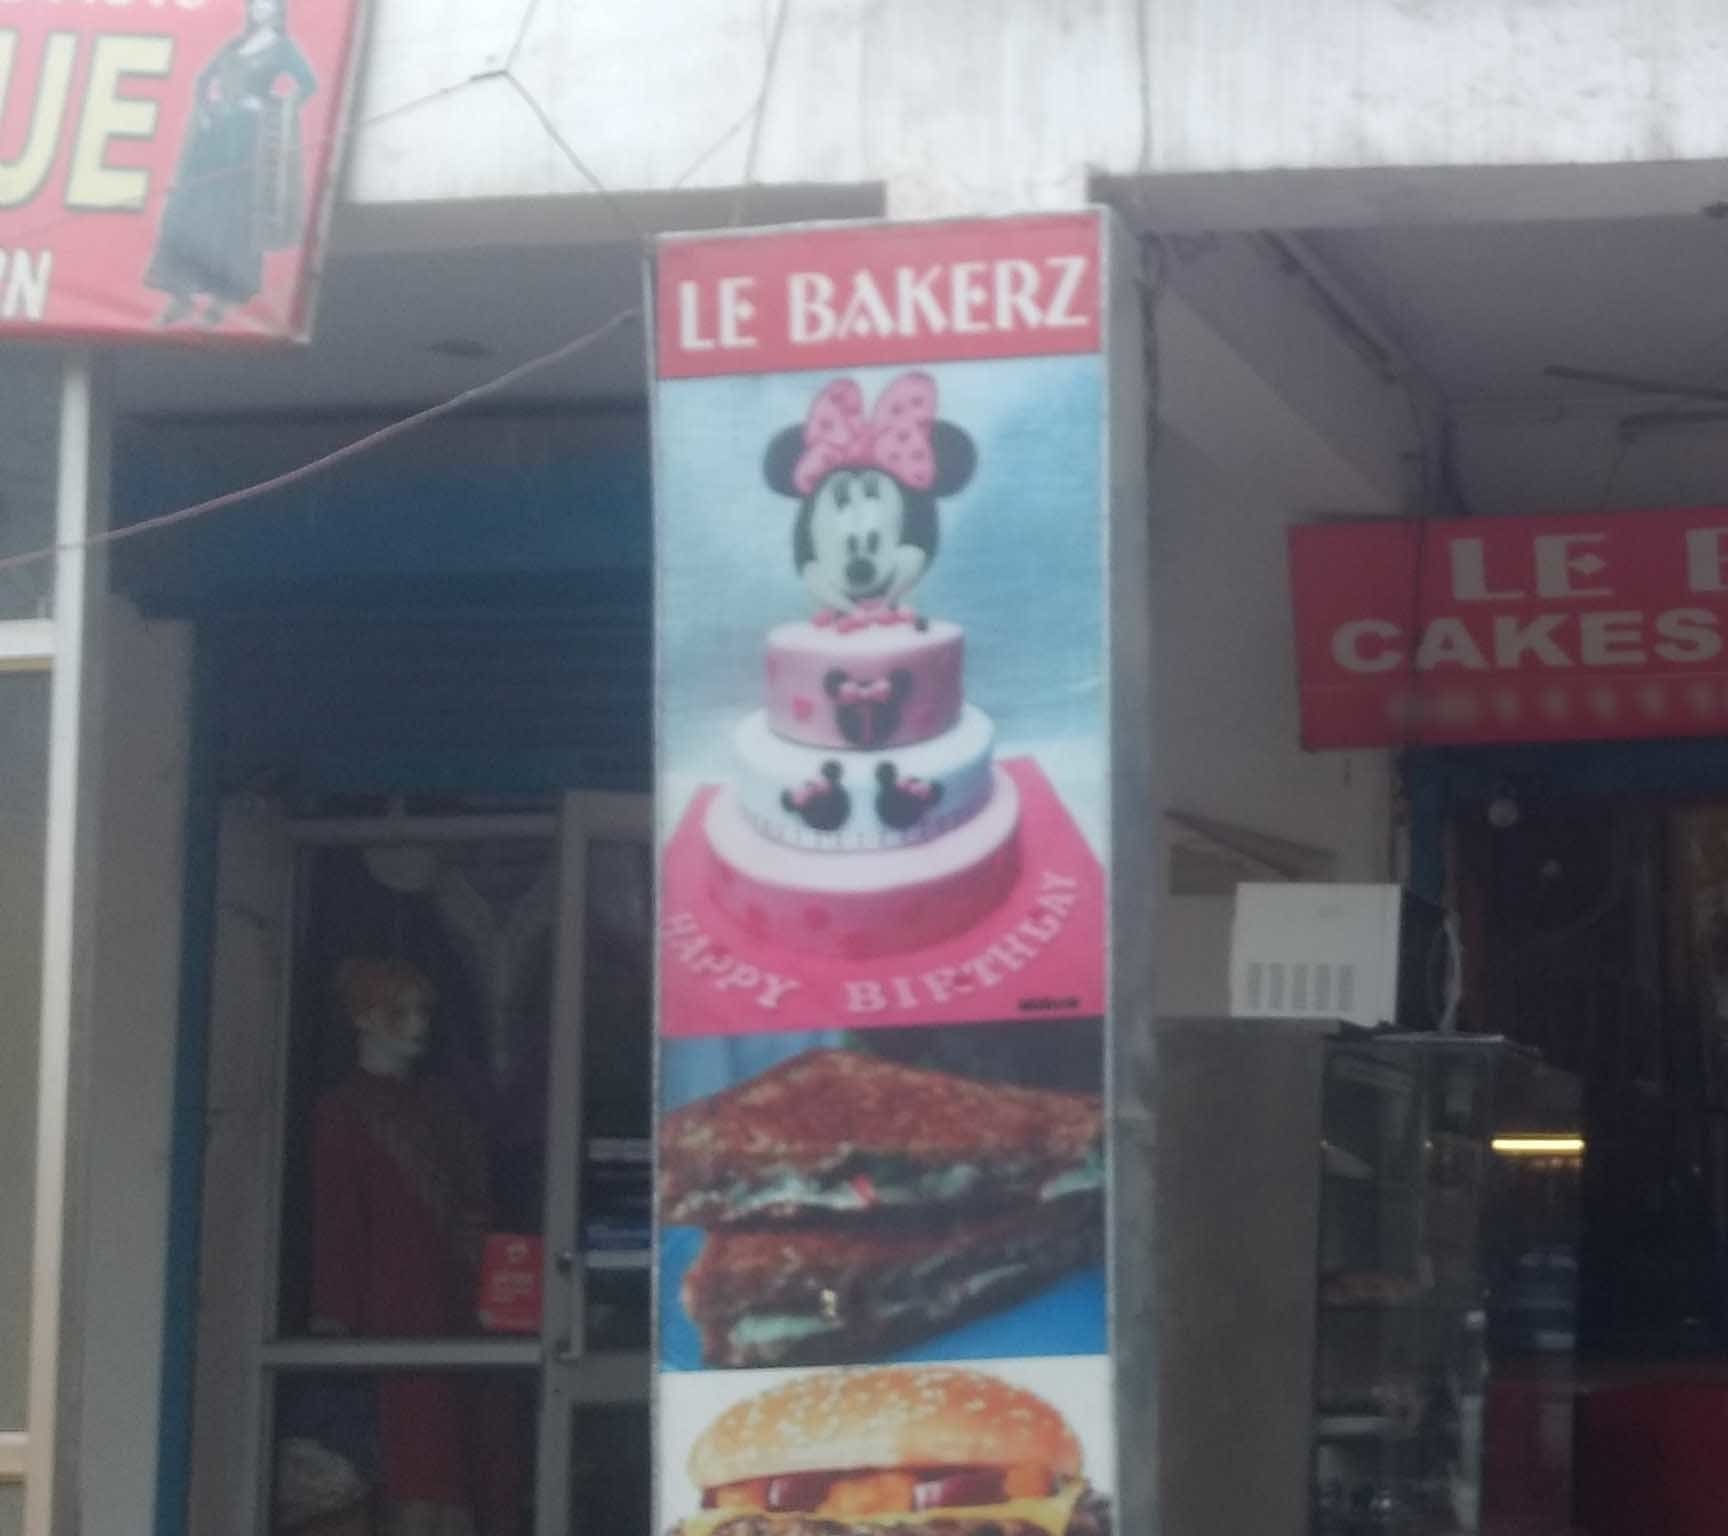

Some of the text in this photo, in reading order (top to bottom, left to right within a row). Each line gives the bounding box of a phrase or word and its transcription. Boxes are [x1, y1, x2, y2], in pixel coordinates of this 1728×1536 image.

[0, 247, 53, 322] N
[678, 255, 1090, 351] LE BAKERZ
[1448, 532, 1614, 602] LE
[1330, 604, 1724, 675] CAKES
